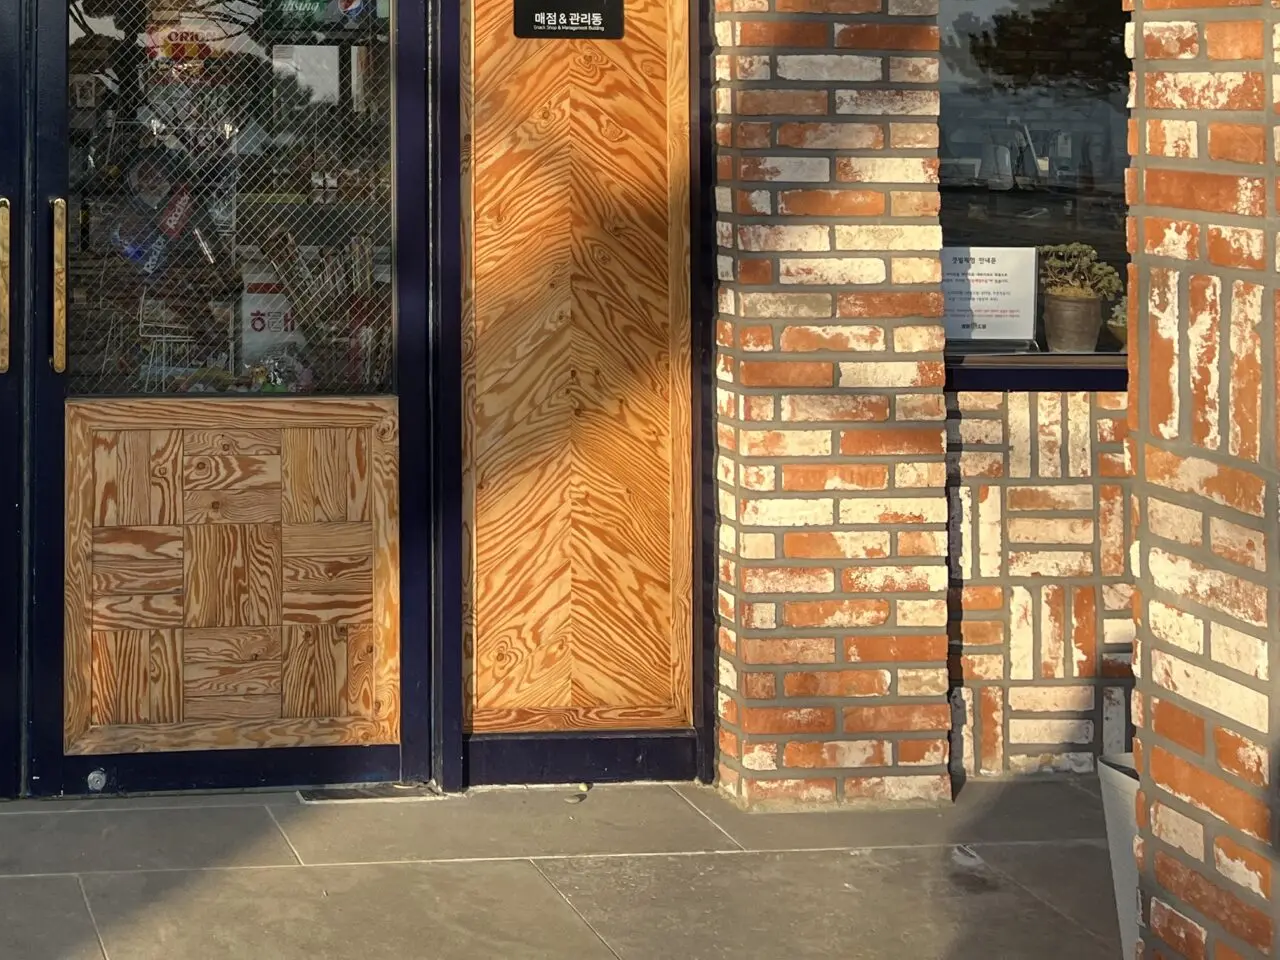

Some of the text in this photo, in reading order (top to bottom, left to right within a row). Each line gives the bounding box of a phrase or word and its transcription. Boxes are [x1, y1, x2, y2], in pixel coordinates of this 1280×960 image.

[534, 12, 603, 26] 매점 & 관리동
